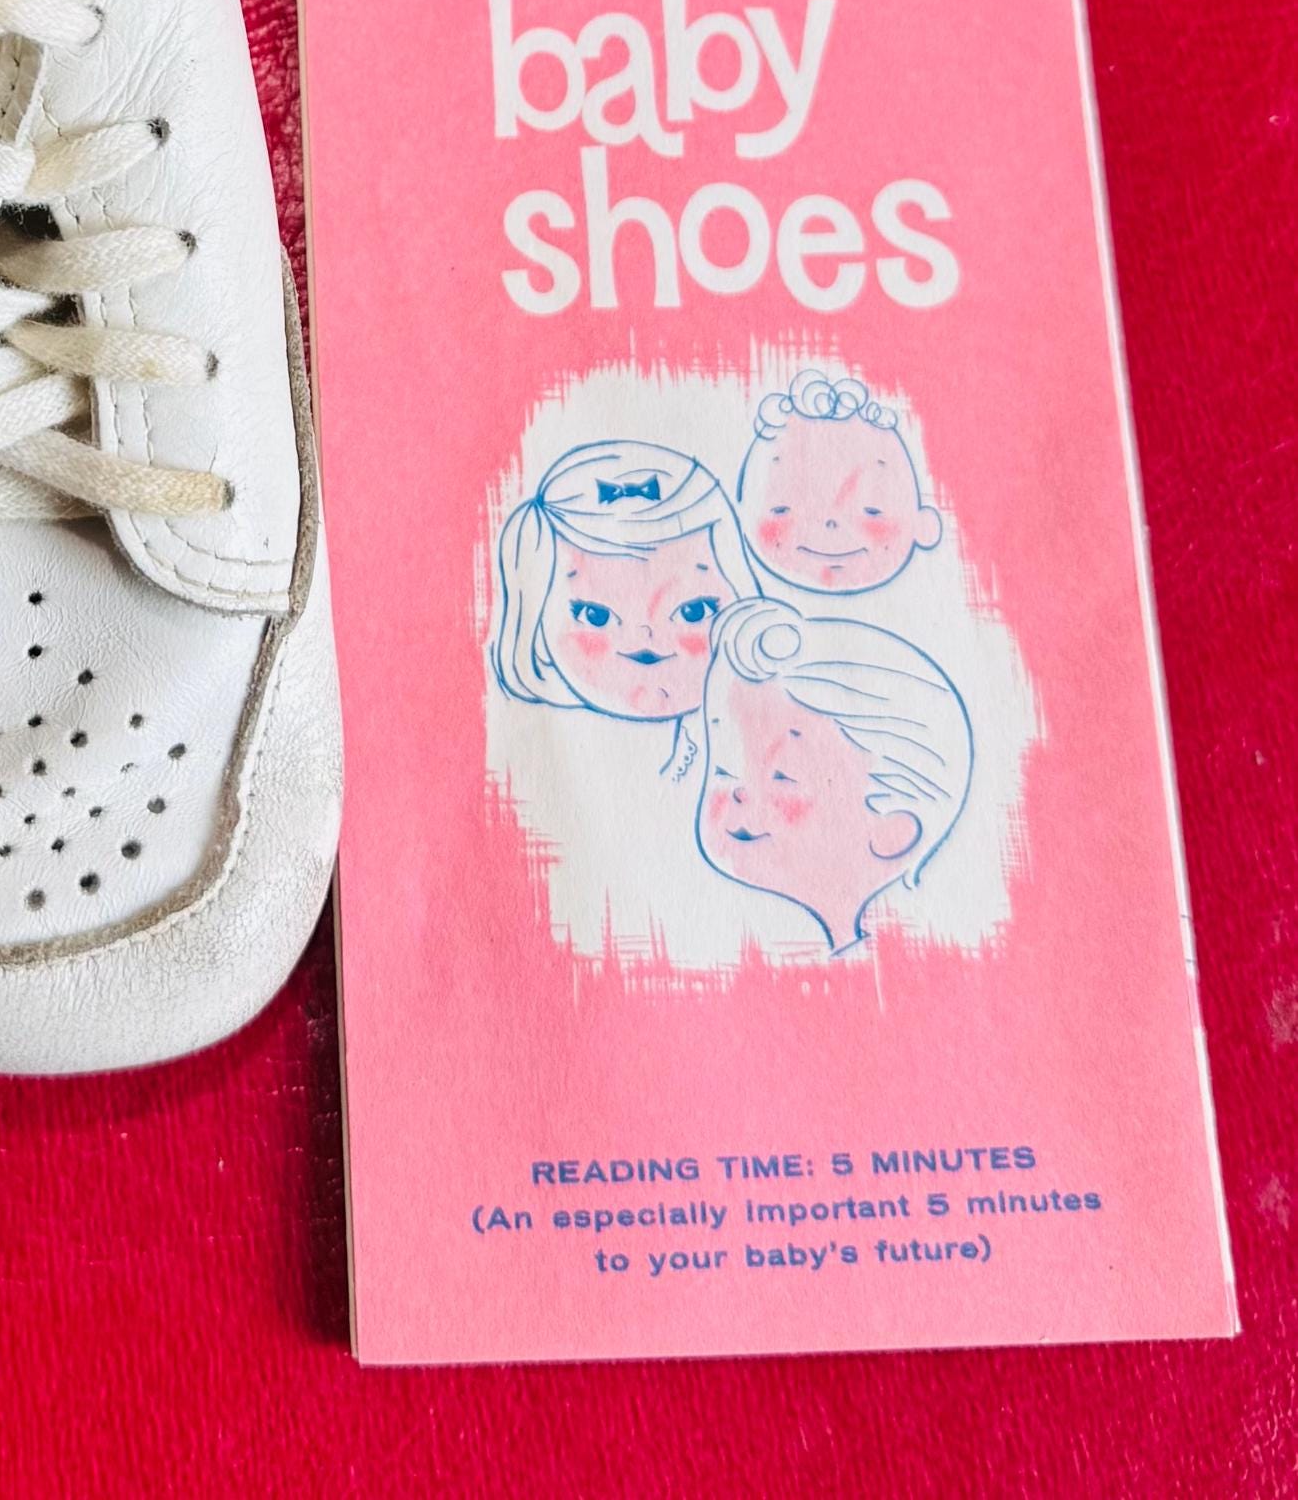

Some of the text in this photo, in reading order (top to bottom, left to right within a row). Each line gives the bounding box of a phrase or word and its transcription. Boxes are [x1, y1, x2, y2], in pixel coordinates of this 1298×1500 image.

[502, 145, 959, 315] shoes
[531, 1146, 1036, 1185] READING TIME: 5 MINUTES
[471, 1189, 1102, 1234] (An especially important 5 minutes
[595, 1234, 992, 1276] to your baby's future)
